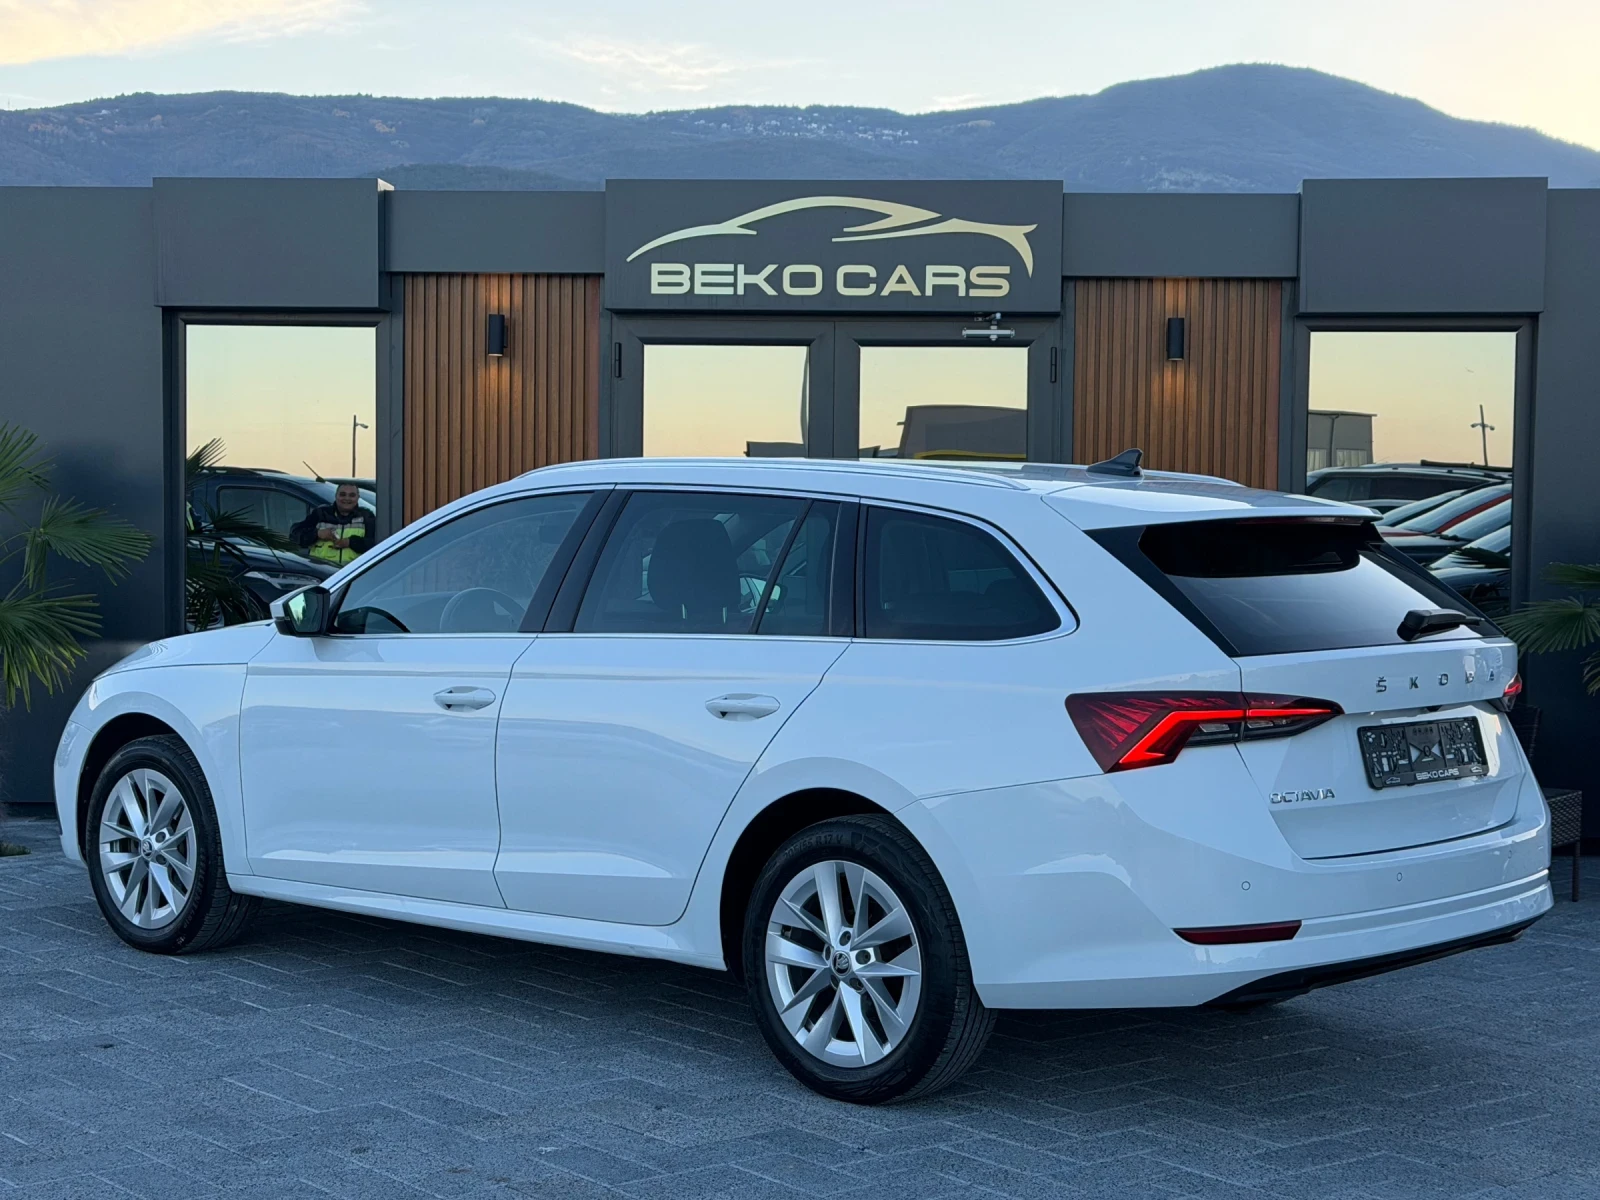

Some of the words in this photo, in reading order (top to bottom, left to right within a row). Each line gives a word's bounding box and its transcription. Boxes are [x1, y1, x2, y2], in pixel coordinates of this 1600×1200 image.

[651, 263, 823, 296] BEKO
[836, 264, 1011, 297] CARS
[1376, 668, 1495, 693] ŠKODA
[1269, 788, 1335, 804] OCTAVIA
